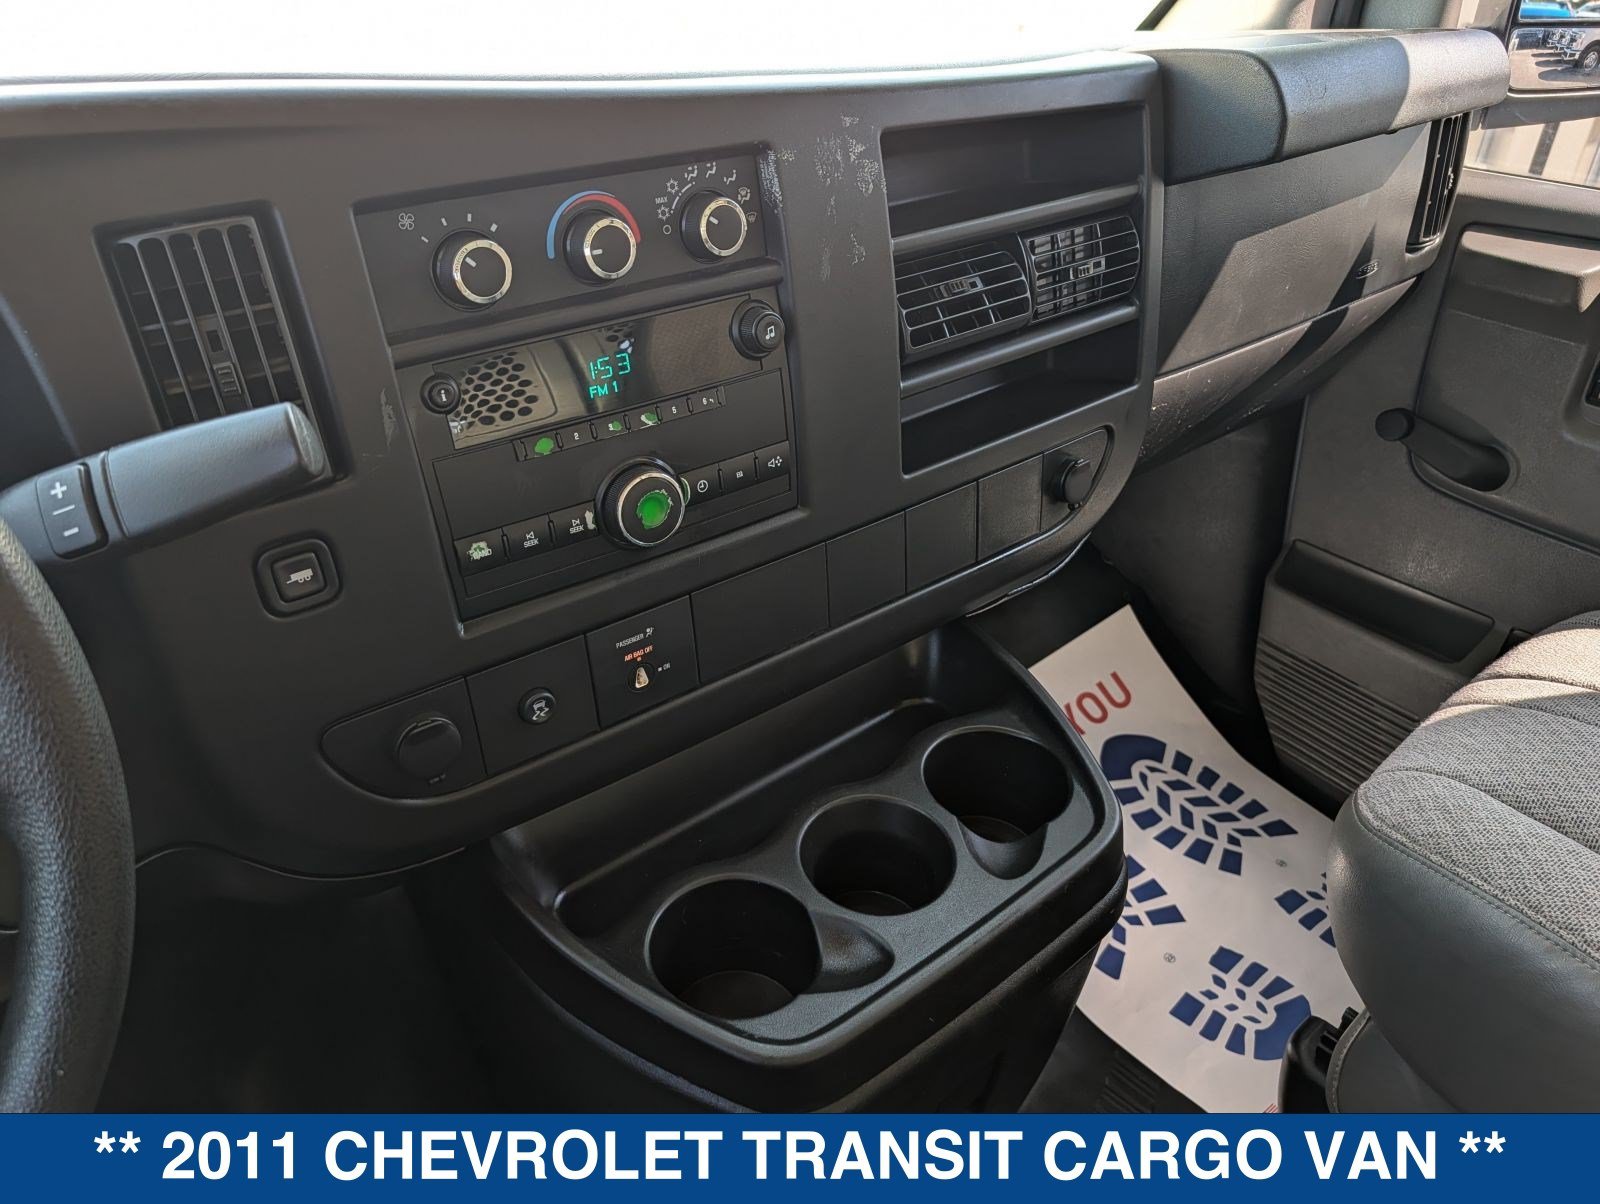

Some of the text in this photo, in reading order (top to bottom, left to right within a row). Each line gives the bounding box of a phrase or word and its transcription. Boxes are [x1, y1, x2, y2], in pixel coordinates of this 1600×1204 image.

[655, 196, 668, 204] MAX
[589, 380, 618, 399] FM 1
[573, 432, 580, 441] 2
[569, 524, 585, 534] SEEK
[523, 538, 539, 548] SEEK
[615, 633, 644, 649] PASSENGER
[624, 645, 653, 662] AIR BAG OFF
[663, 662, 671, 671] ON
[1064, 671, 1132, 736] YOU
